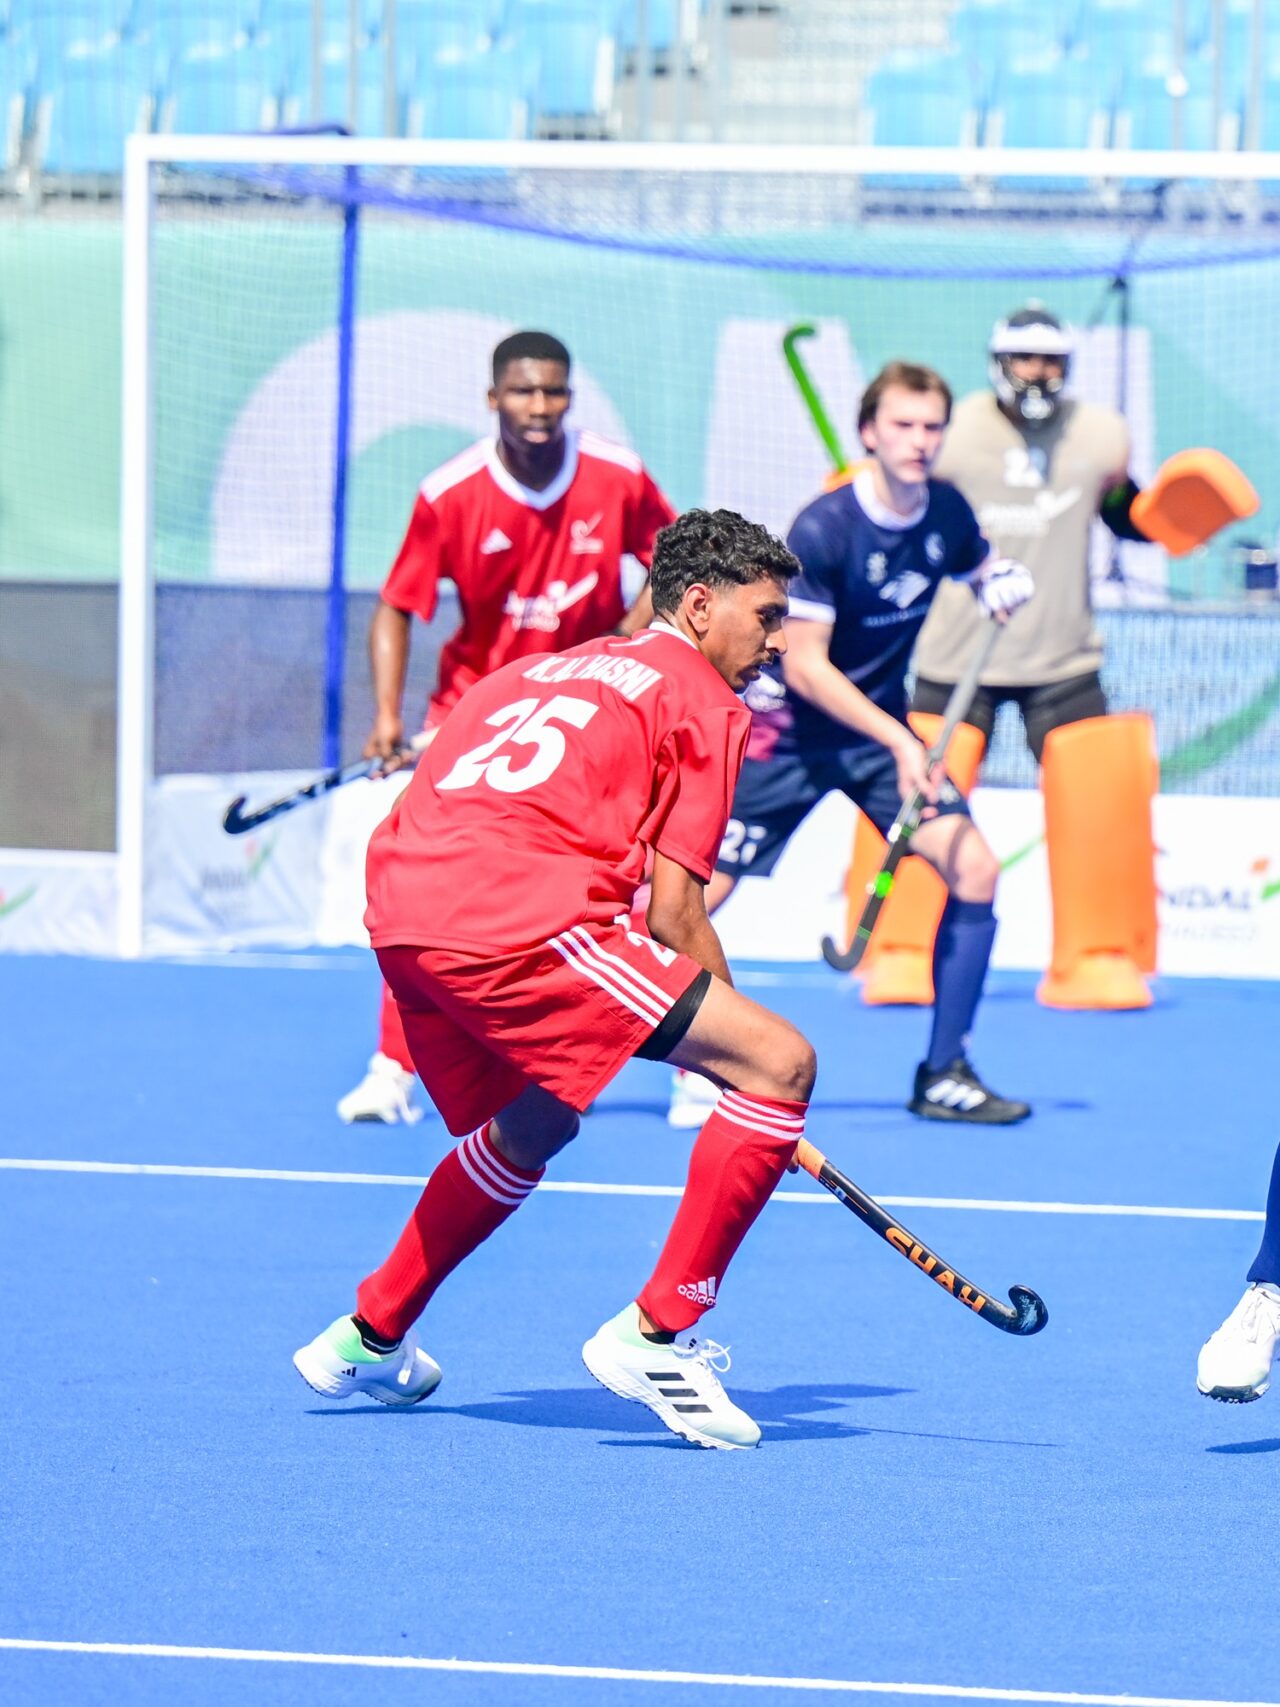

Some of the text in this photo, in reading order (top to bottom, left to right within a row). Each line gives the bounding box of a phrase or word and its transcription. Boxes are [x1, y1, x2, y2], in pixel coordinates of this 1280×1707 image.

[572, 654, 664, 701] HASNI
[435, 694, 600, 793] 25
[677, 1284, 716, 1306] adida
